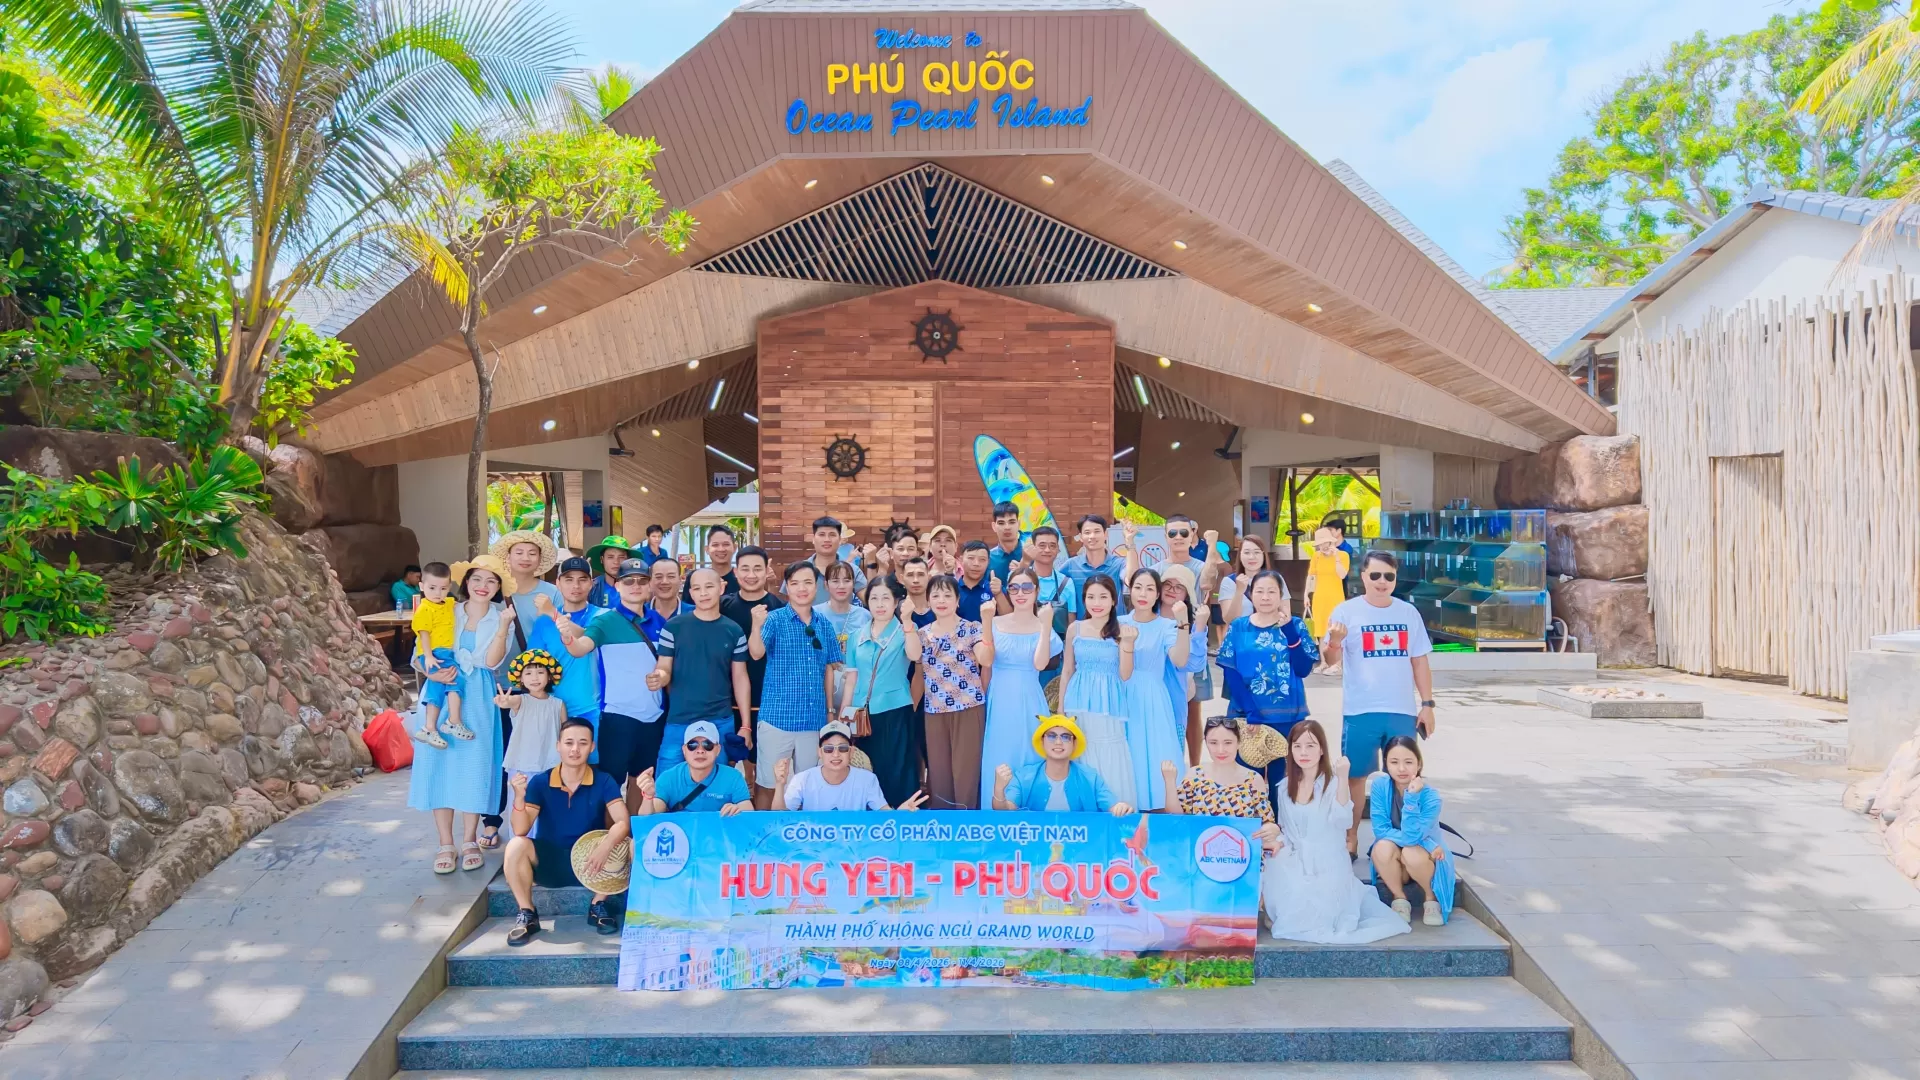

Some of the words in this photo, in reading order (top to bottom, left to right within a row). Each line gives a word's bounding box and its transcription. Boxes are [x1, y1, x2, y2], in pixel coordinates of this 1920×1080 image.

[874, 28, 953, 49] Welcome
[965, 31, 983, 47] to
[827, 54, 904, 94] PHÚ
[923, 51, 1034, 94] QUỐC
[785, 99, 873, 135] Ocean
[890, 98, 980, 136] Pearl
[992, 93, 1093, 130] Island
[1366, 649, 1407, 657] CANADA
[783, 823, 836, 840] CÔNG
[842, 826, 864, 840] TY
[870, 820, 896, 840] CỔ
[901, 819, 950, 840] PHẦN
[957, 826, 995, 840] ABC
[999, 823, 1040, 845] VIỆT
[1046, 827, 1086, 841] NAM
[721, 862, 827, 898] HƯNG
[840, 857, 914, 897] YÊN
[926, 874, 941, 883] -
[954, 851, 1030, 896] PHÚ
[1042, 849, 1159, 902] QUỐC
[785, 921, 836, 938] THÀNH
[842, 920, 878, 938] PHỐ
[879, 921, 934, 938] KHÔNG
[977, 924, 1032, 938] GRAND
[1037, 926, 1094, 940] WORLD
[870, 959, 895, 968] Ngày
